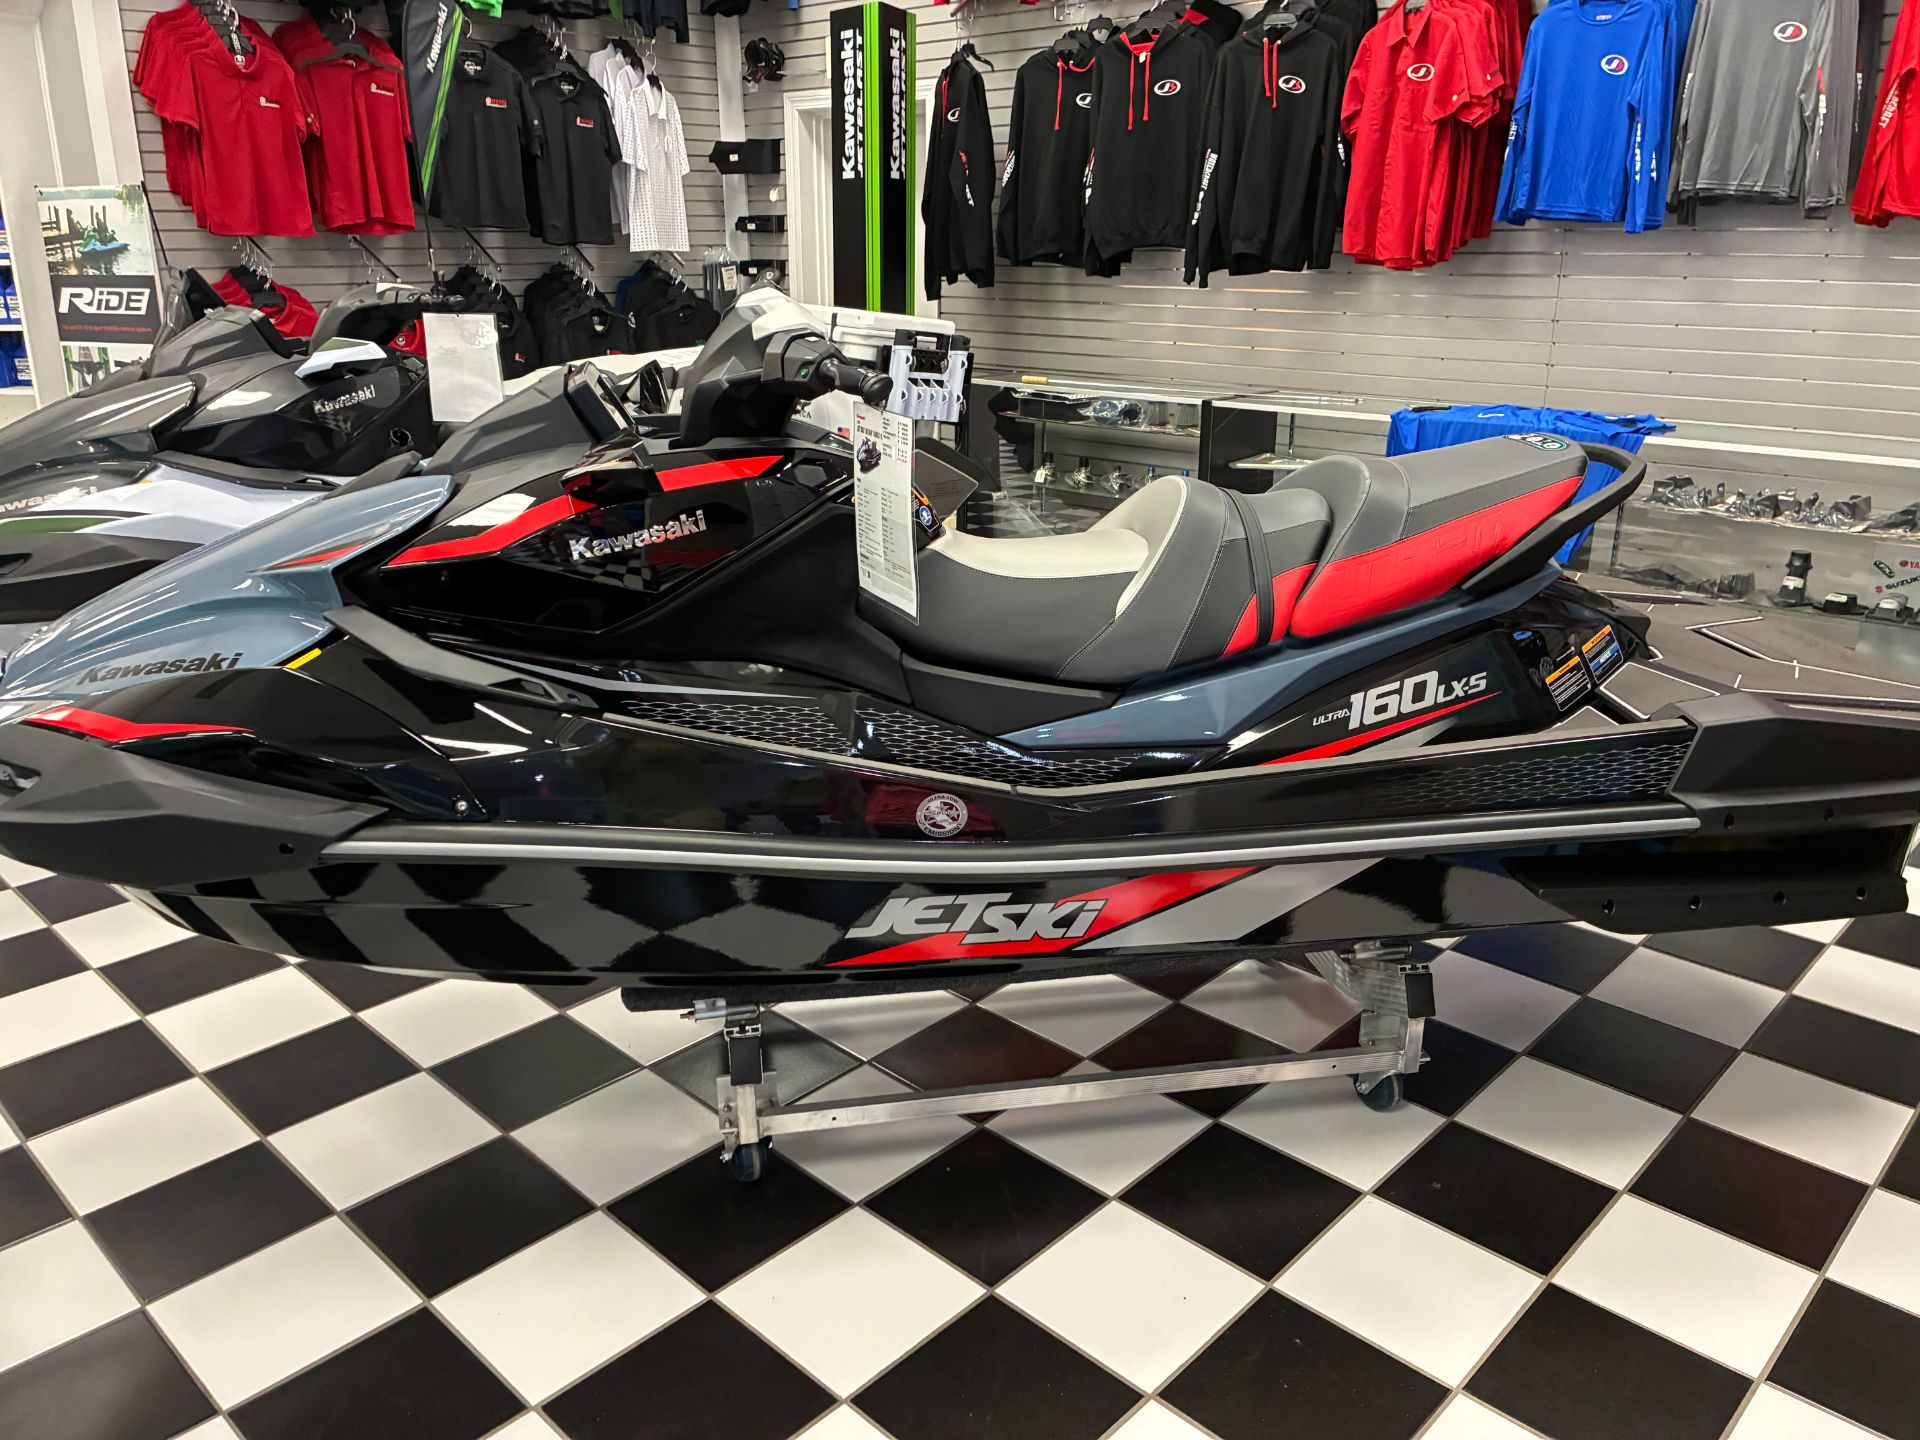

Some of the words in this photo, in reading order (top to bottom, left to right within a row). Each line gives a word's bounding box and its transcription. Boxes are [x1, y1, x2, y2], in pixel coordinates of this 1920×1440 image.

[426, 2, 448, 74] Kawasaki
[840, 29, 855, 180] Kawasaki
[889, 28, 900, 180] Kawasaki
[312, 384, 376, 415] Kawasaki
[568, 510, 707, 561] Kawasaki
[76, 652, 244, 686] Kawasaki
[1312, 708, 1351, 727] ULTRA
[1348, 670, 1439, 731] 160
[1437, 671, 1488, 704] LX-S
